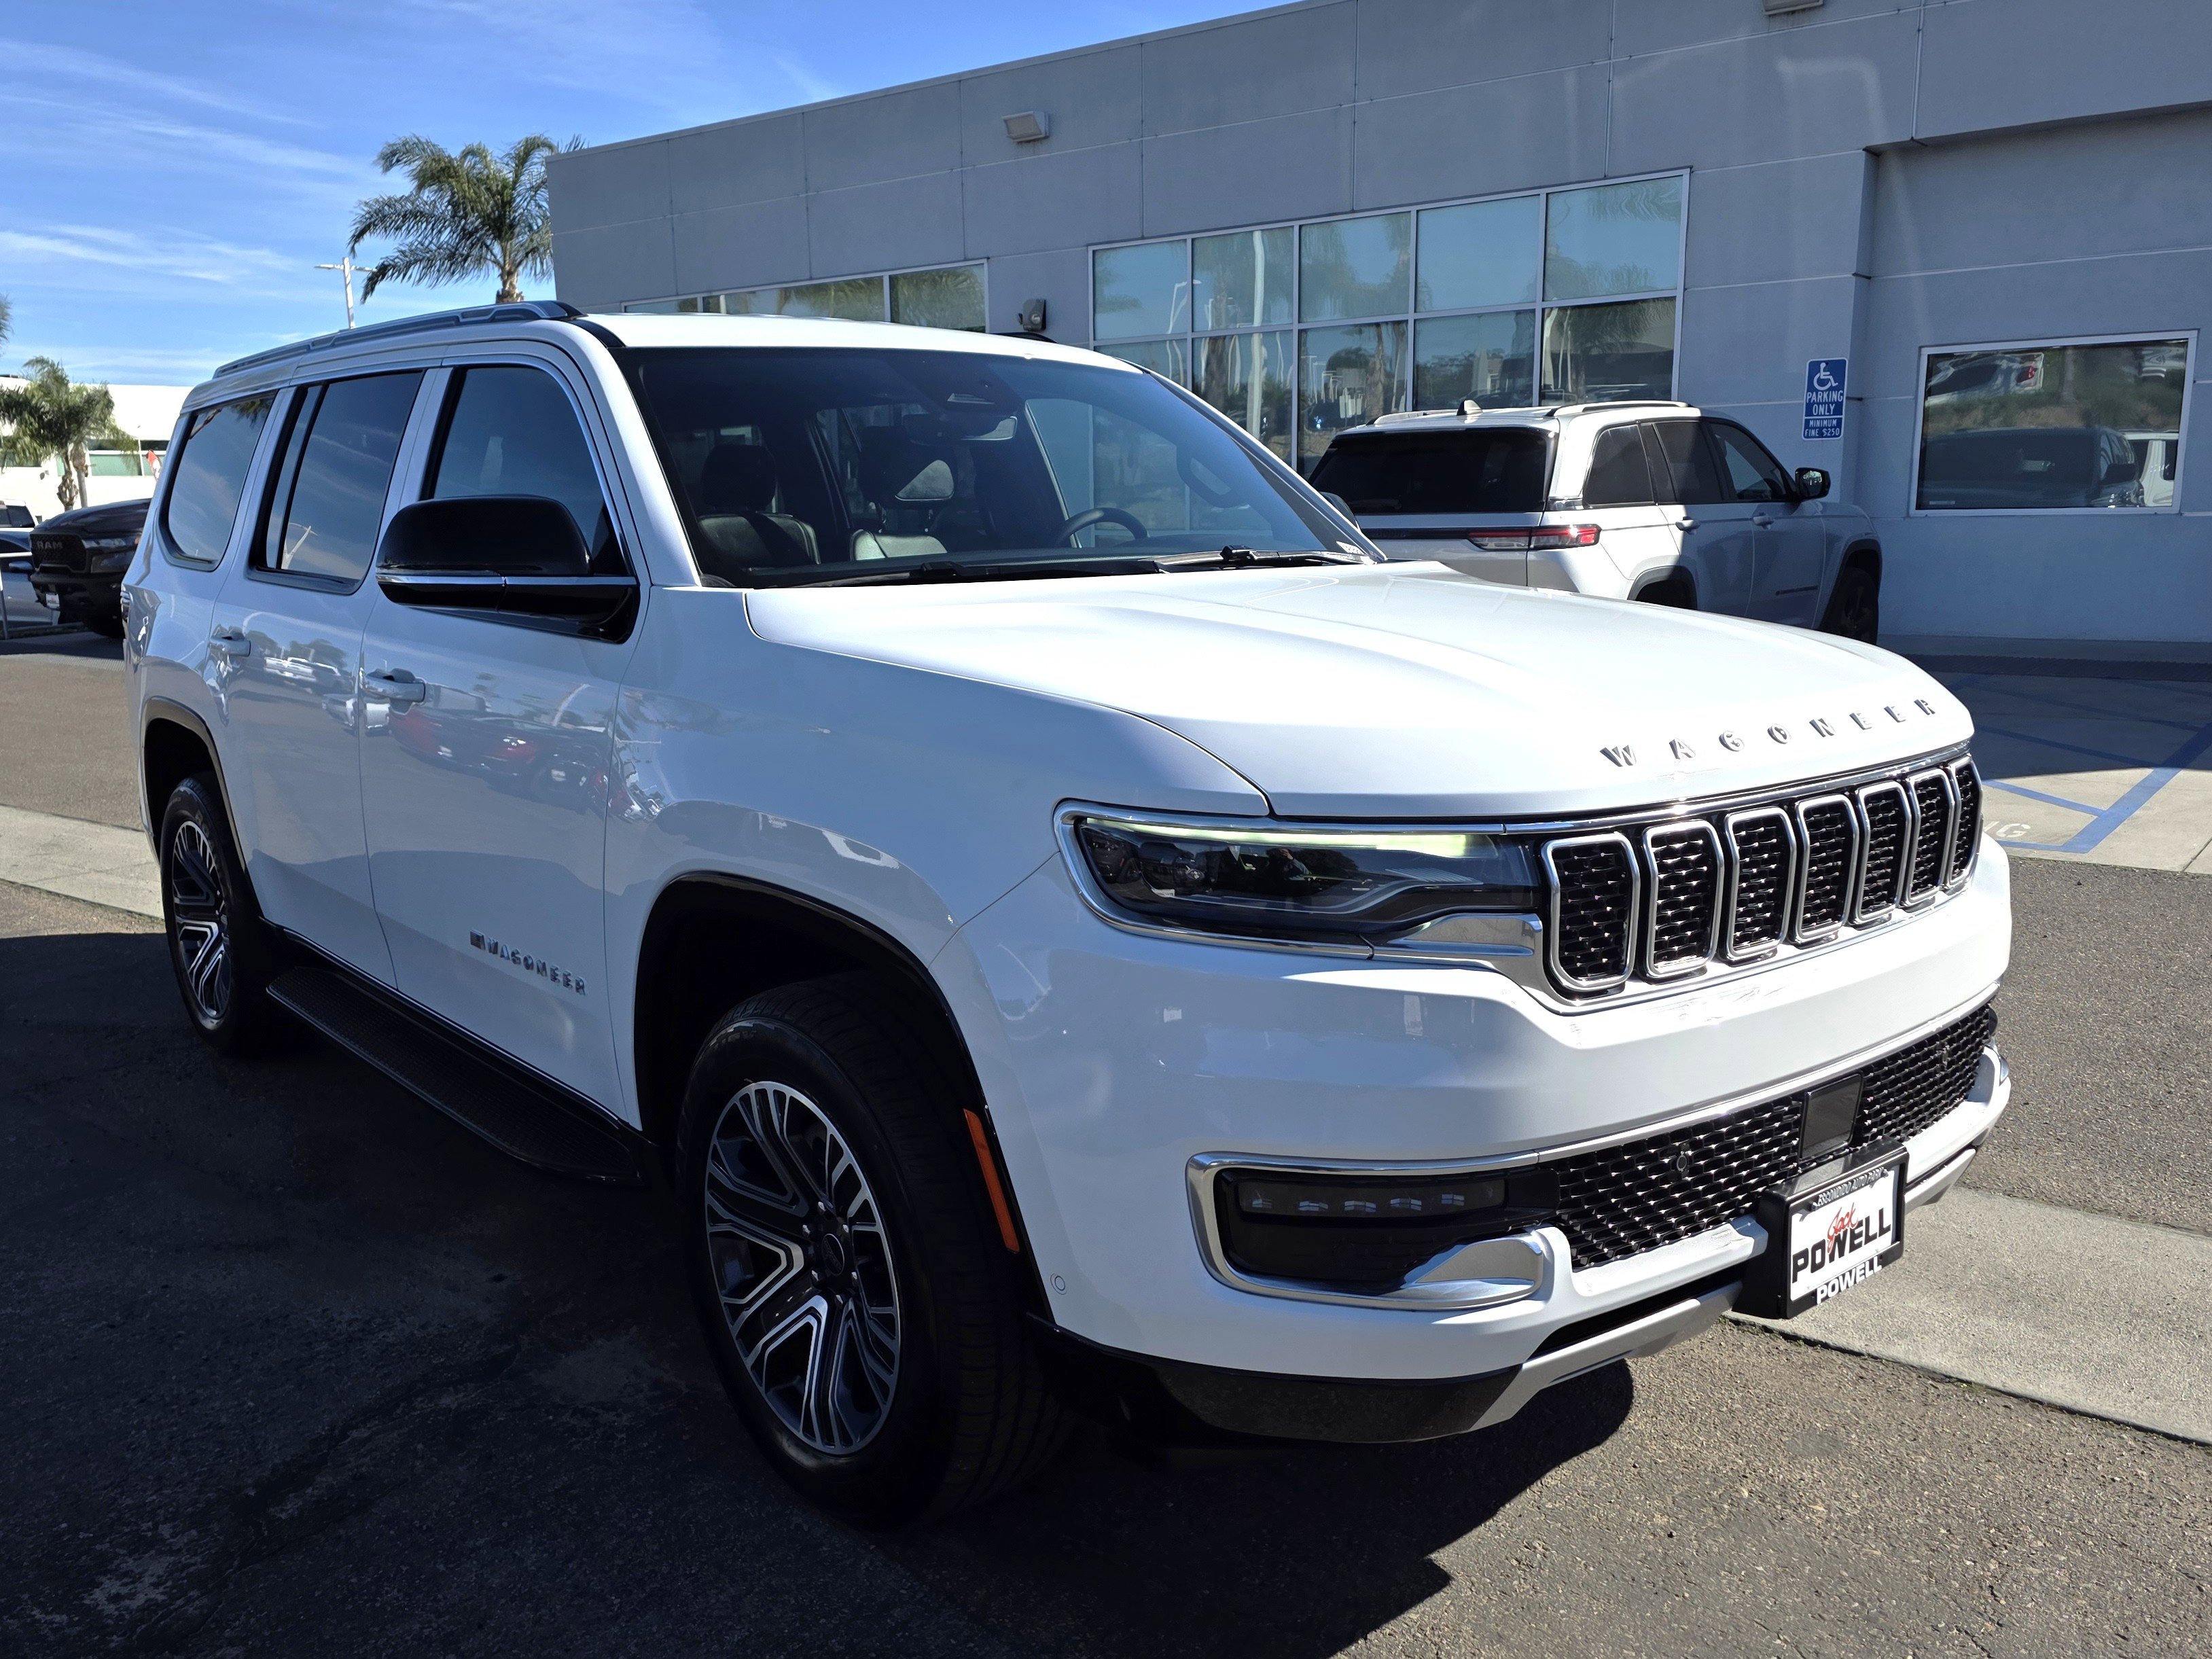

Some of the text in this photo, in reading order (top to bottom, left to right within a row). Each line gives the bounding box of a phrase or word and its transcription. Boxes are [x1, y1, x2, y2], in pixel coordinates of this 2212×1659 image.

[1806, 390, 1843, 403] PARKING
[1813, 404, 1835, 415] ONLY
[1805, 428, 1840, 437] FINE $250
[1809, 419, 1837, 427] MINIMUM
[37, 540, 63, 550] RAM
[1599, 698, 1936, 767] WAGONEER
[487, 937, 586, 995] WAGONEER
[1827, 1202, 1858, 1253] Jack
[1791, 1208, 1891, 1283] POWELL
[1817, 1256, 1882, 1304] POWELL
